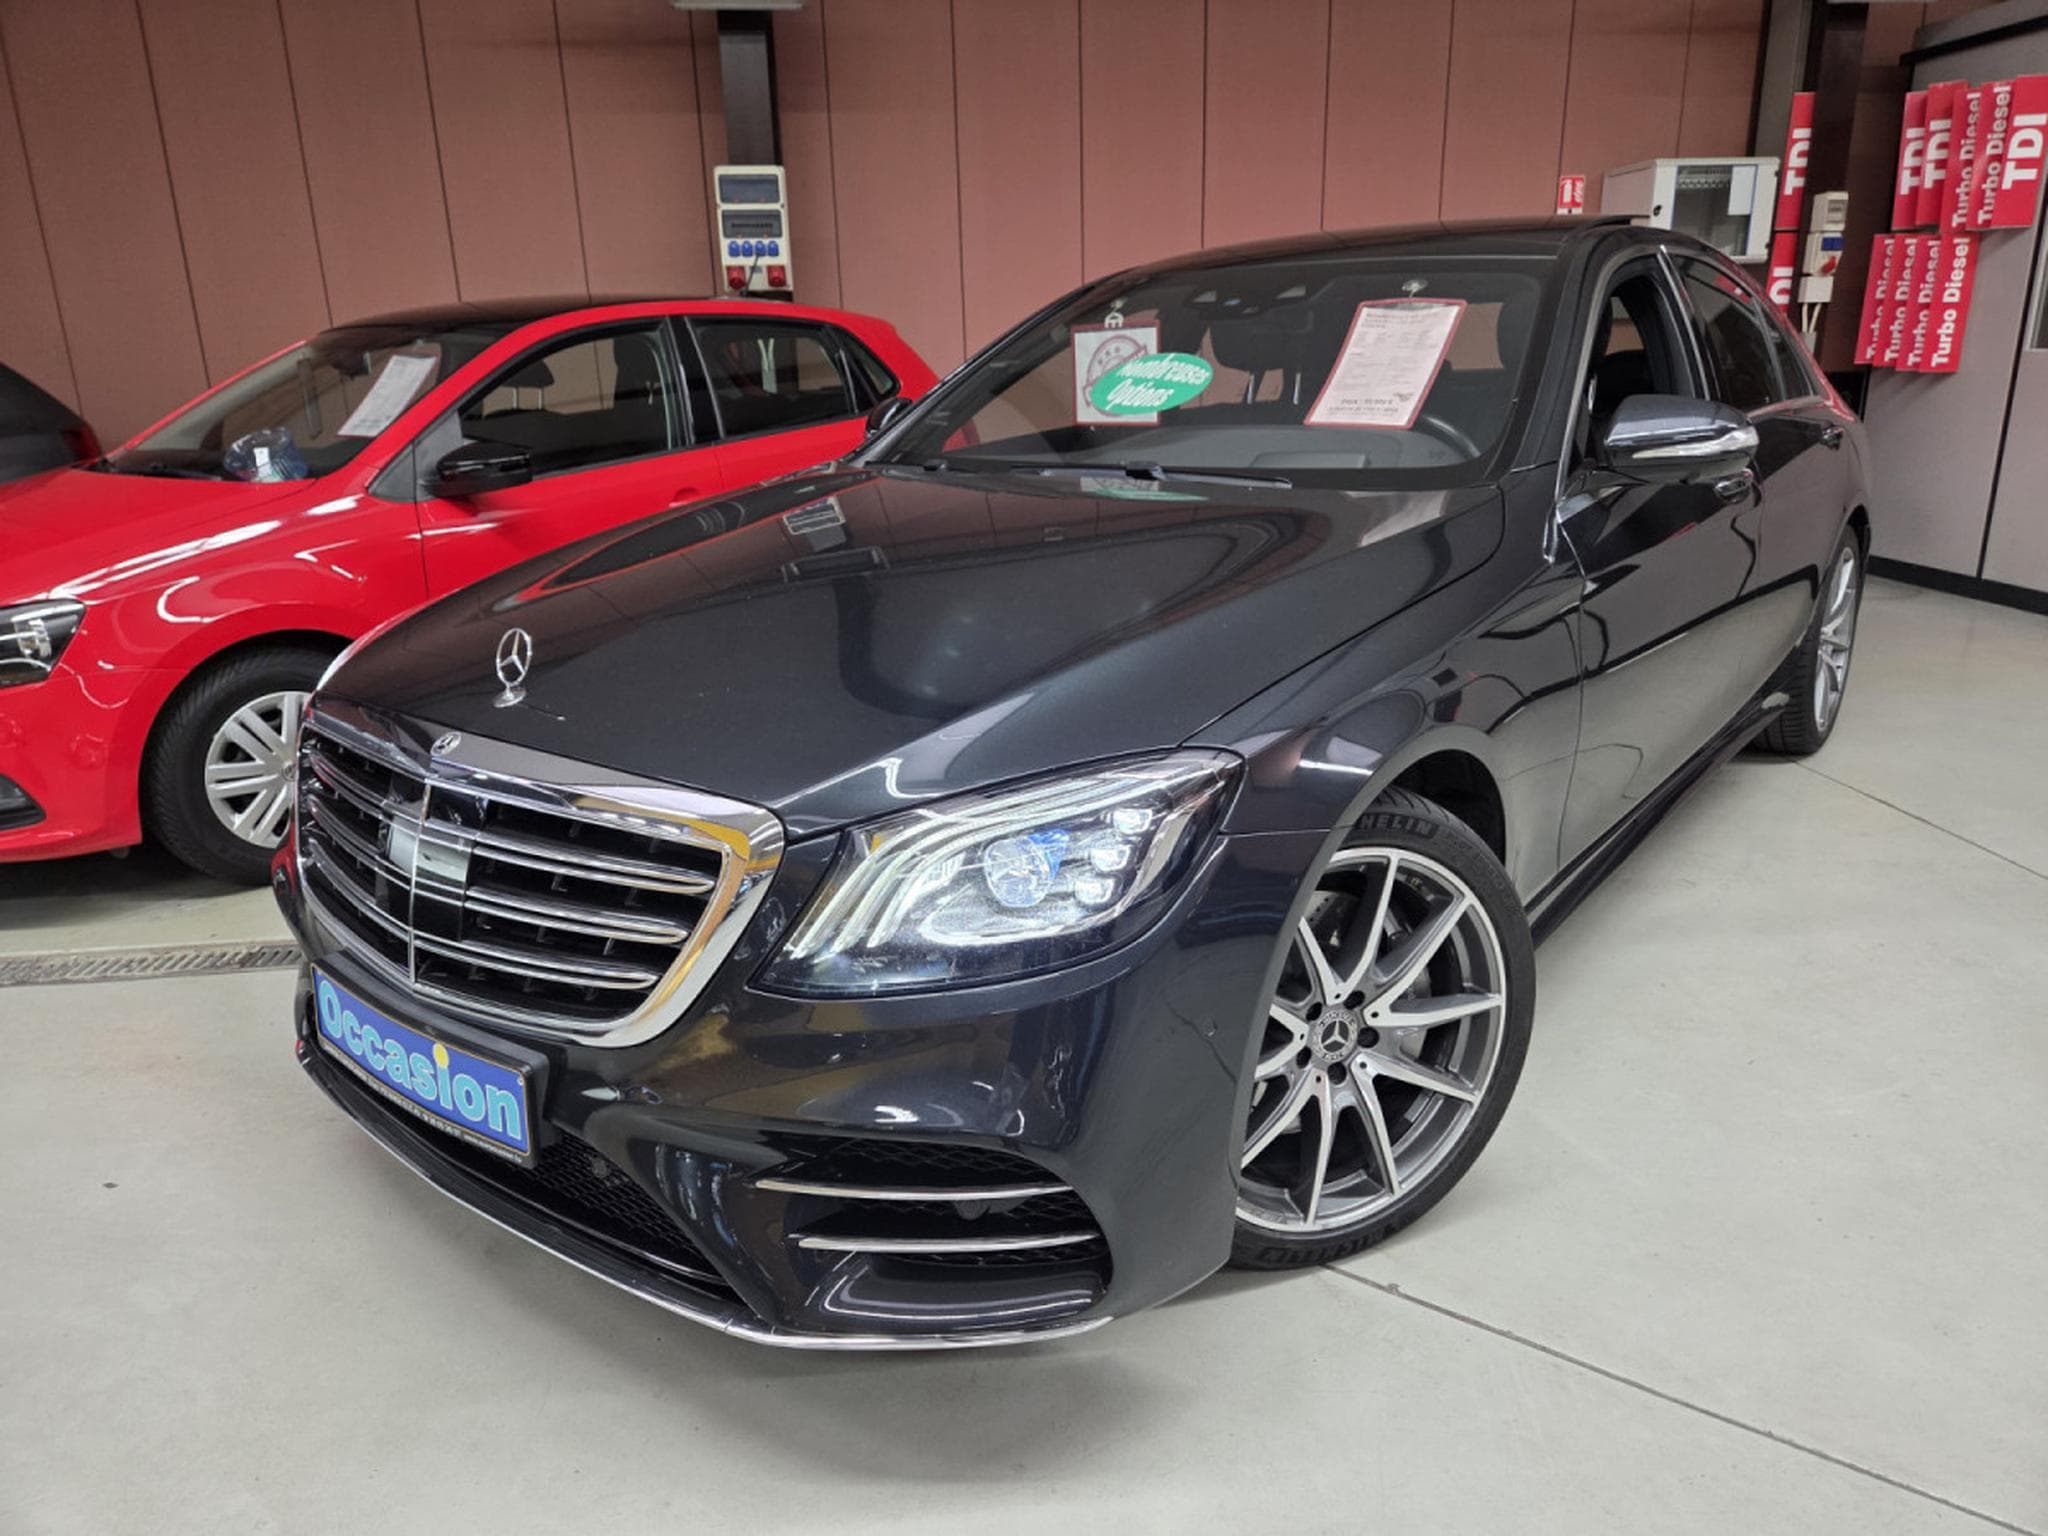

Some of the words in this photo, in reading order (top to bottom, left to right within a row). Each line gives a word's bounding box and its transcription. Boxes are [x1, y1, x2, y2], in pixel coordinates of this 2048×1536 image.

[1985, 84, 2012, 156] Diesel
[2001, 113, 2048, 190] TDI
[1977, 161, 2000, 225] Turbo
[1769, 266, 1793, 305] DI
[1942, 237, 1970, 303] Diesel
[1930, 308, 1957, 368] Turbo
[1105, 378, 1175, 411] Options
[318, 978, 523, 1141] Occasion
